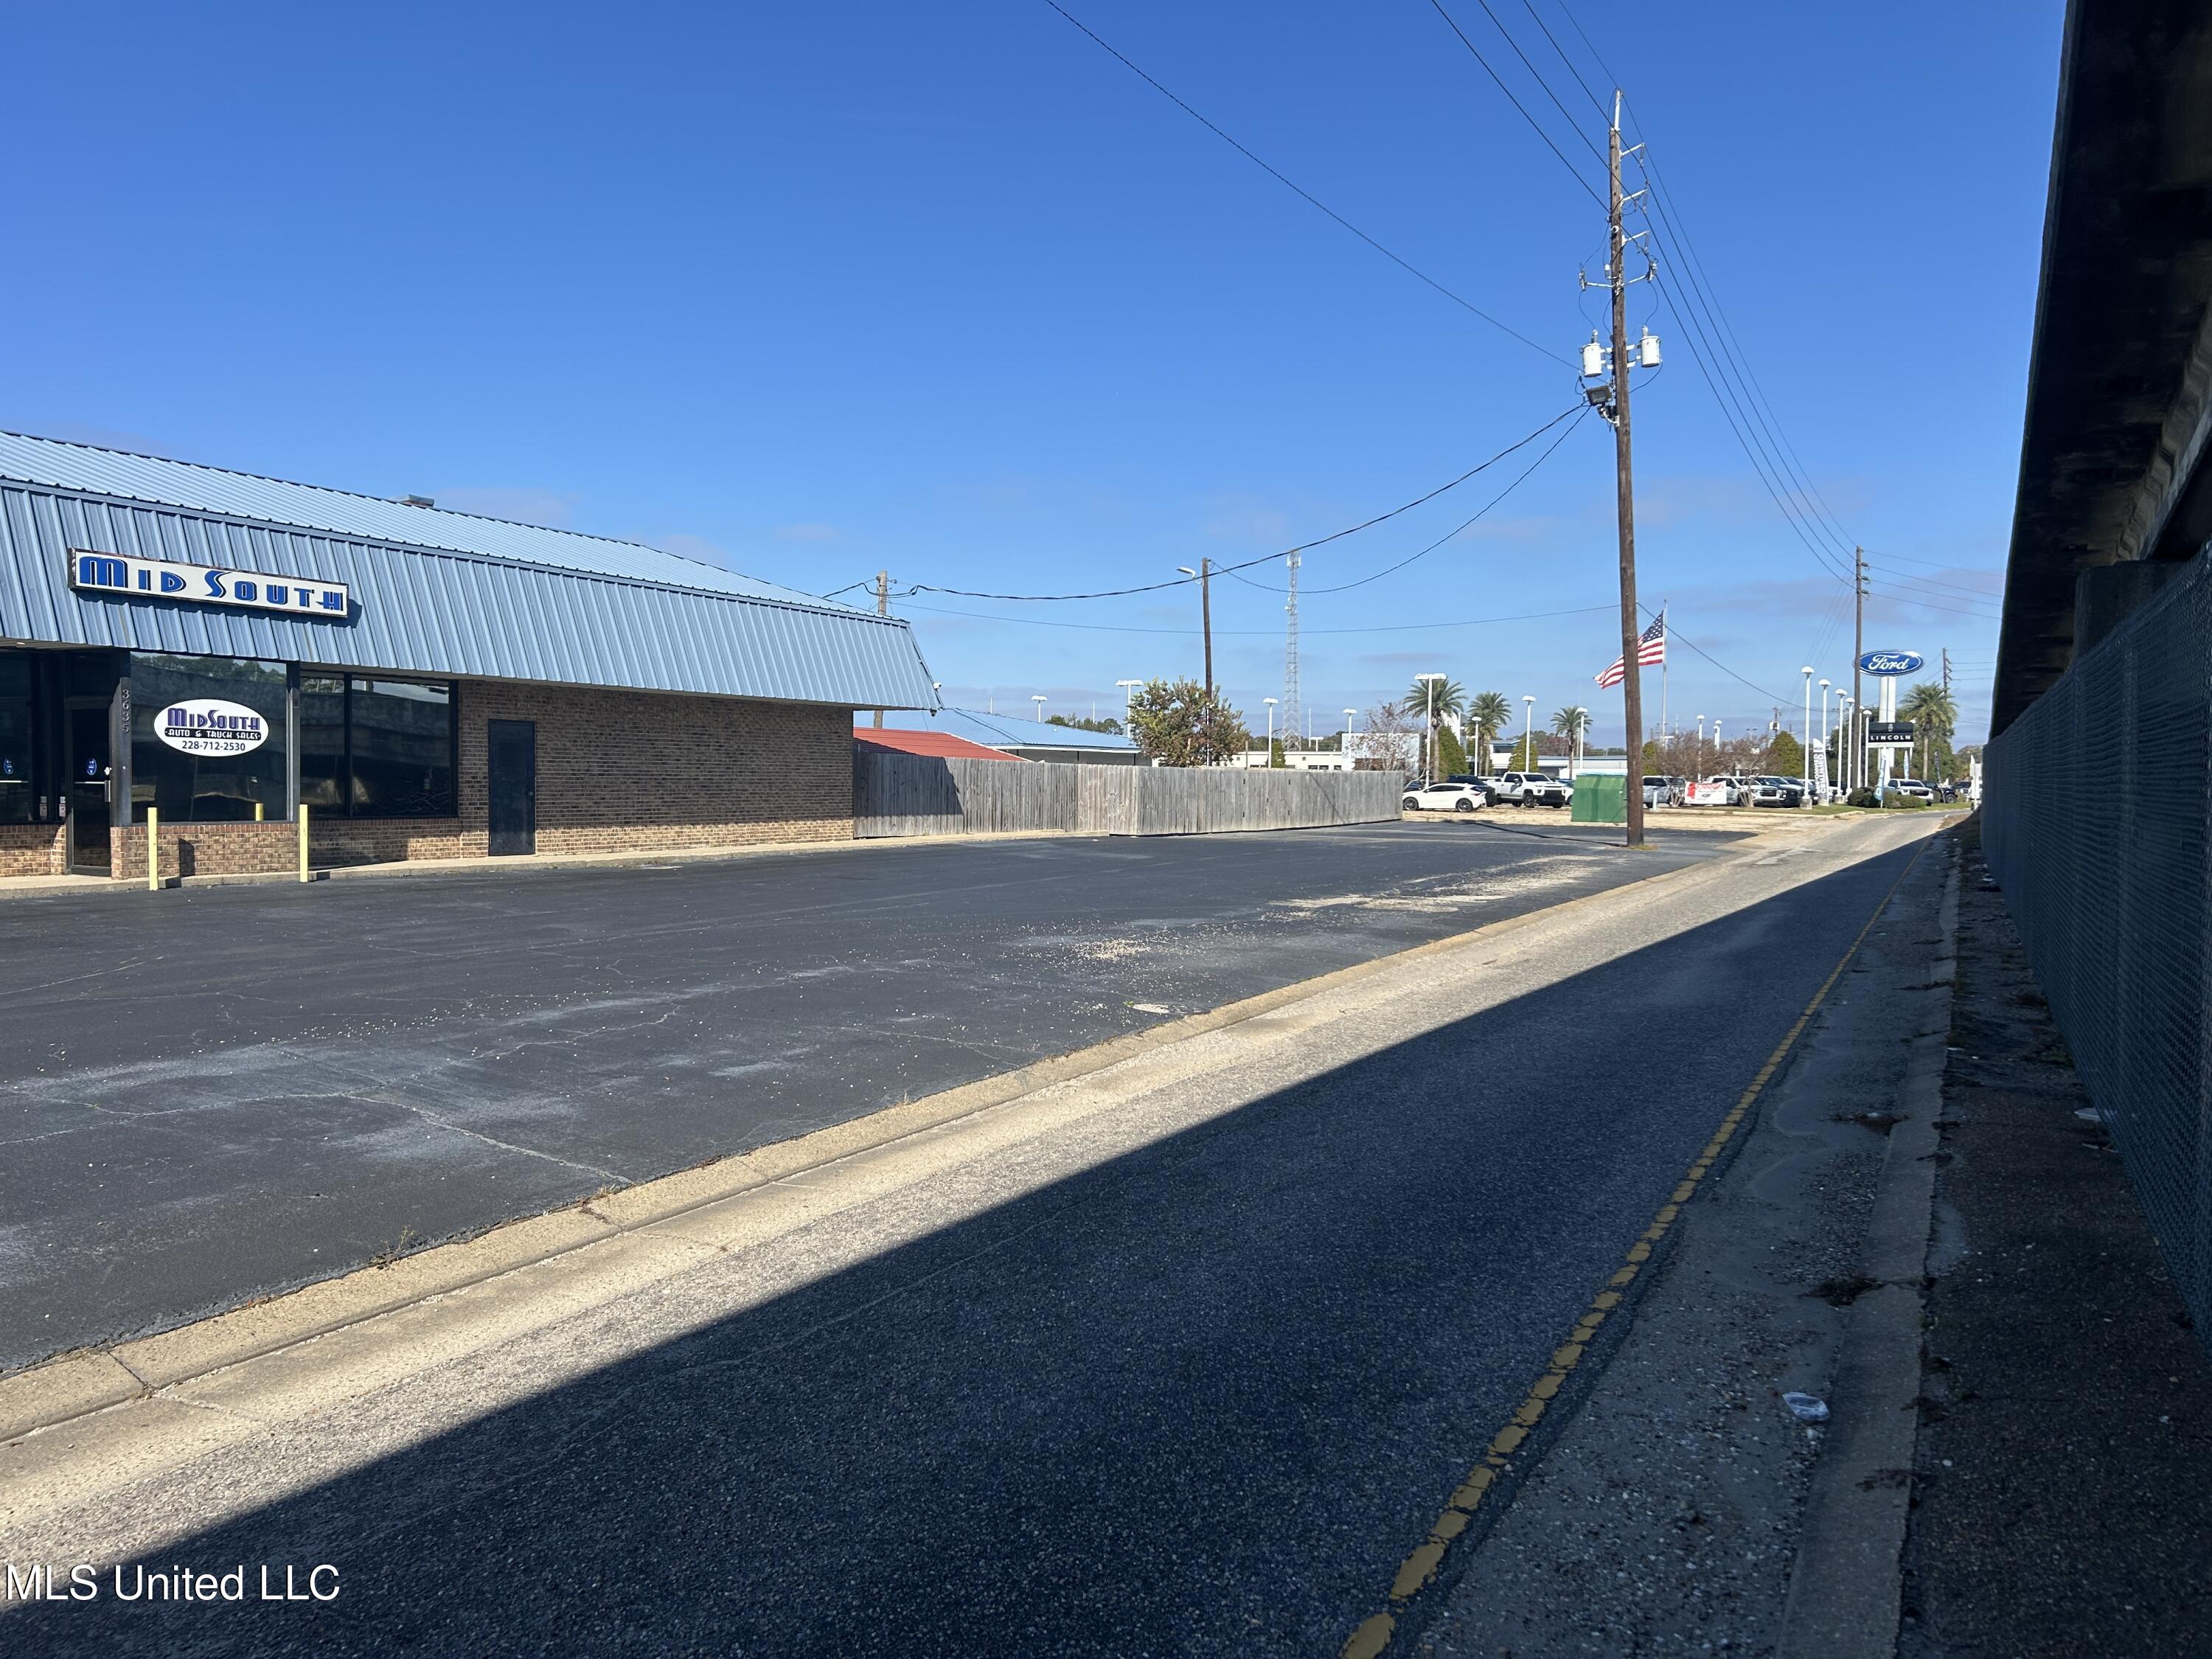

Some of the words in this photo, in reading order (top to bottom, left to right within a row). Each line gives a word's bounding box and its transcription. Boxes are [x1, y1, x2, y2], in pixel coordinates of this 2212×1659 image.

[1868, 654, 1910, 670] Ford
[122, 689, 131, 733] 3635
[167, 728, 190, 737] AUTO
[237, 731, 259, 740] SALES
[181, 740, 246, 751] 228-712-2530
